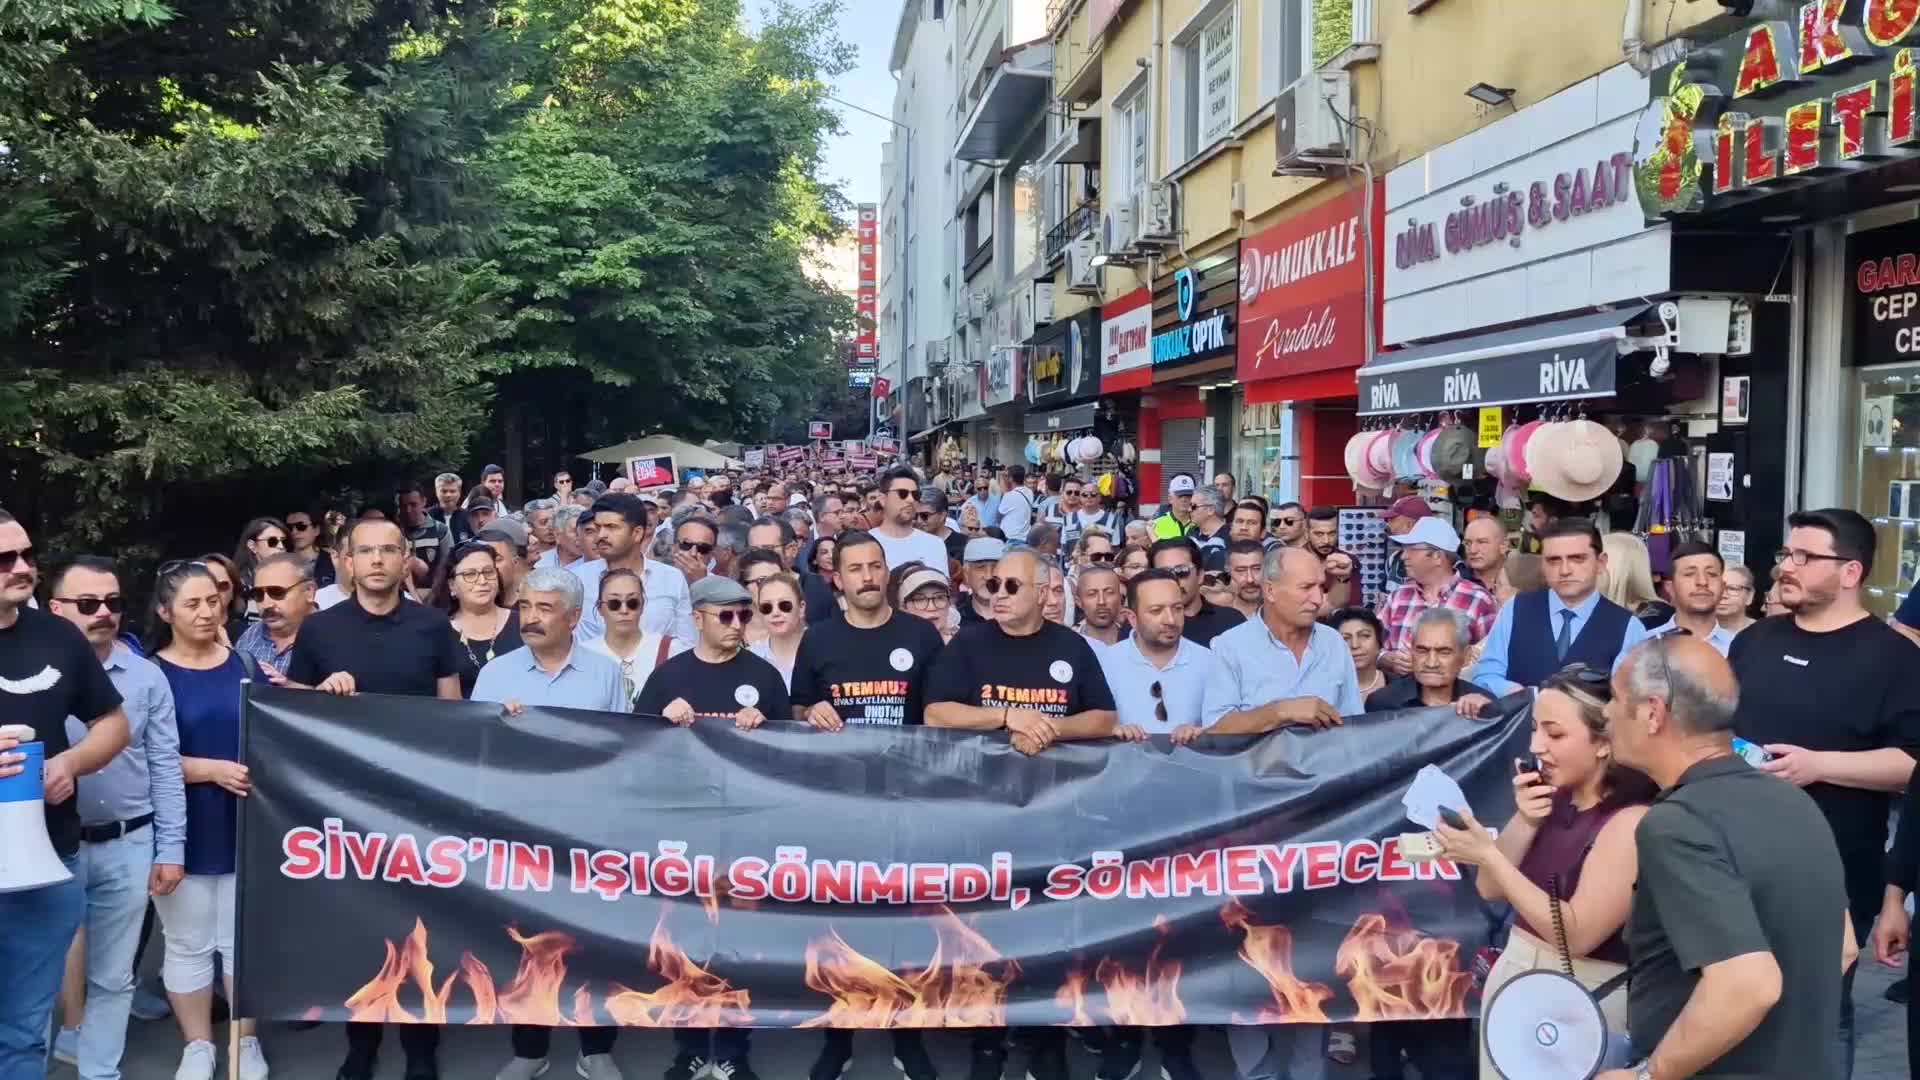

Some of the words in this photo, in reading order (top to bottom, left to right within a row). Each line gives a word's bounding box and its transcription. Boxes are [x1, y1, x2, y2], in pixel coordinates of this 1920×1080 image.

[1205, 15, 1233, 56] AVUKA
[1713, 48, 1917, 195] İLETİ
[1445, 181, 1525, 254] GÜMÜŞ
[1528, 181, 1551, 228] &
[1553, 152, 1634, 221] SAAT
[860, 209, 876, 272] OTEL
[1261, 216, 1358, 293] PAMUKKALE
[1857, 253, 1920, 293] GAR
[1873, 292, 1918, 321] CEP
[1151, 325, 1191, 364] TURKUAZ
[1192, 308, 1225, 353] OPTİK
[1255, 305, 1336, 368] Anadolu
[1371, 378, 1400, 409] RİVA
[1444, 368, 1482, 403] RİVA
[1539, 353, 1590, 394] RİVA
[831, 684, 841, 698] 2
[842, 681, 908, 697] TEMMUZ
[833, 696, 855, 706] SİVAS
[865, 705, 904, 718] UNUTMA
[981, 684, 992, 699] 2
[996, 685, 1068, 703] TEMMUZ
[280, 817, 553, 892] SİVAS'IN
[570, 840, 714, 901] IŞIĞI
[727, 846, 1031, 911] SÖNMEDİ,
